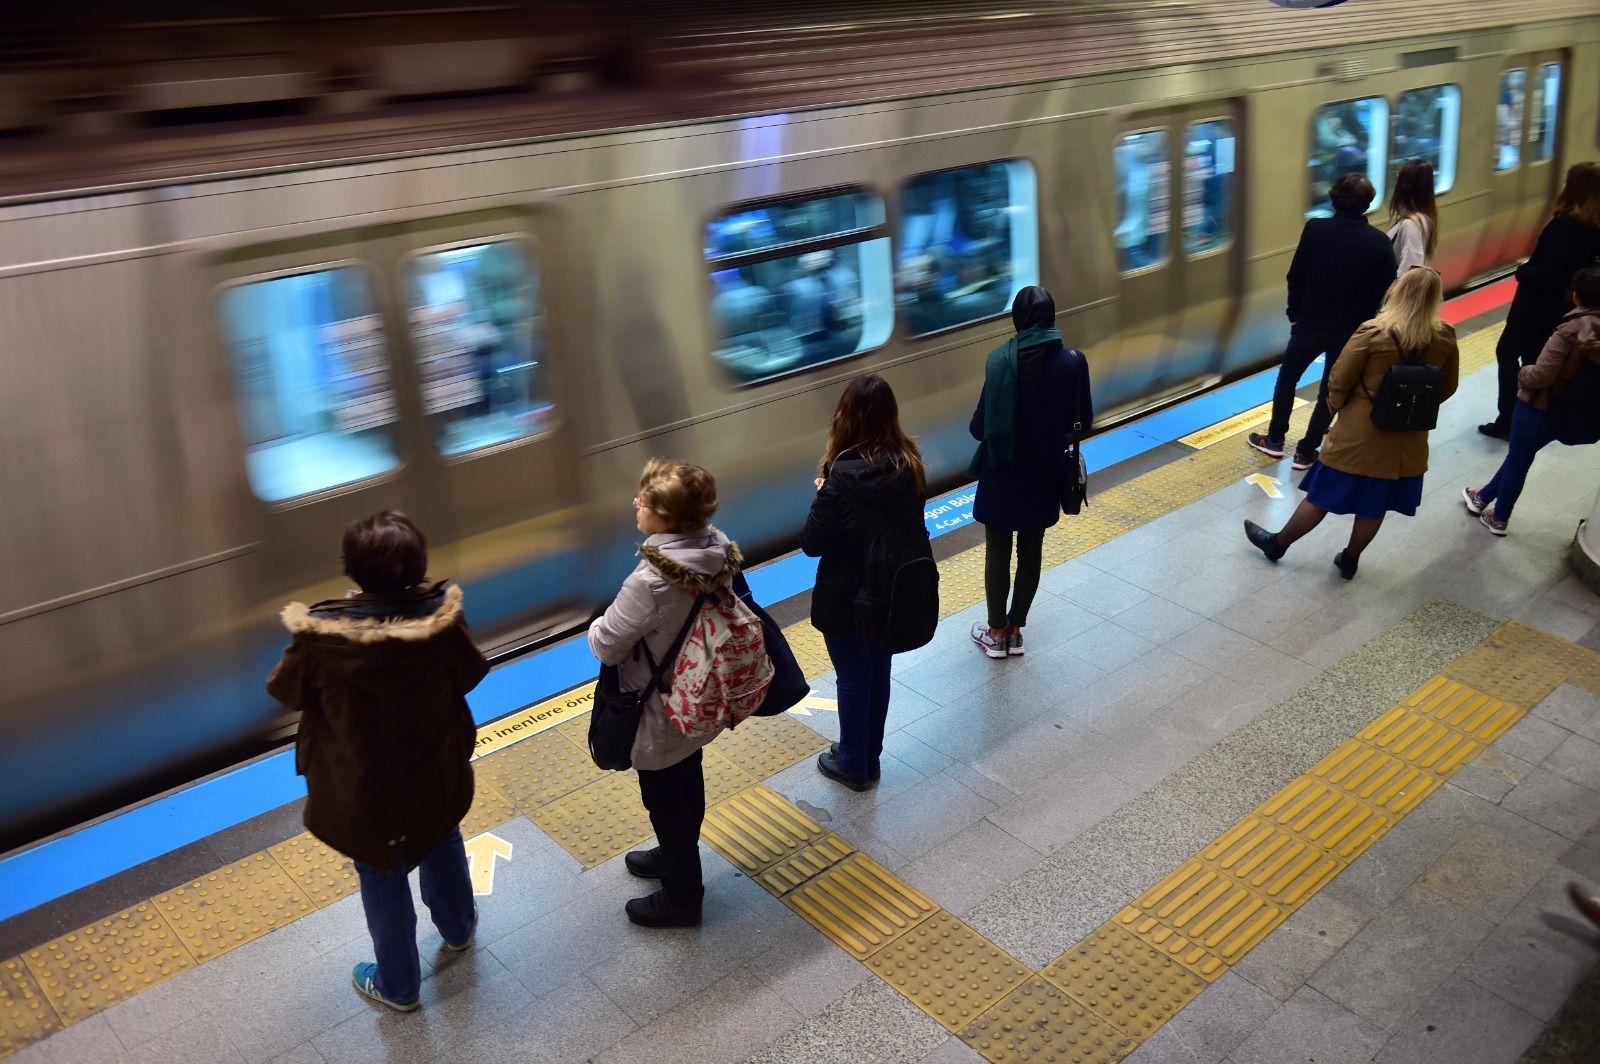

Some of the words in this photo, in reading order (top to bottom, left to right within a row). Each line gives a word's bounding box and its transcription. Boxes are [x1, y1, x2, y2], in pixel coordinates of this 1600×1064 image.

[474, 736, 493, 748] en
[494, 707, 564, 738] inenlere
[566, 693, 595, 708] önc
